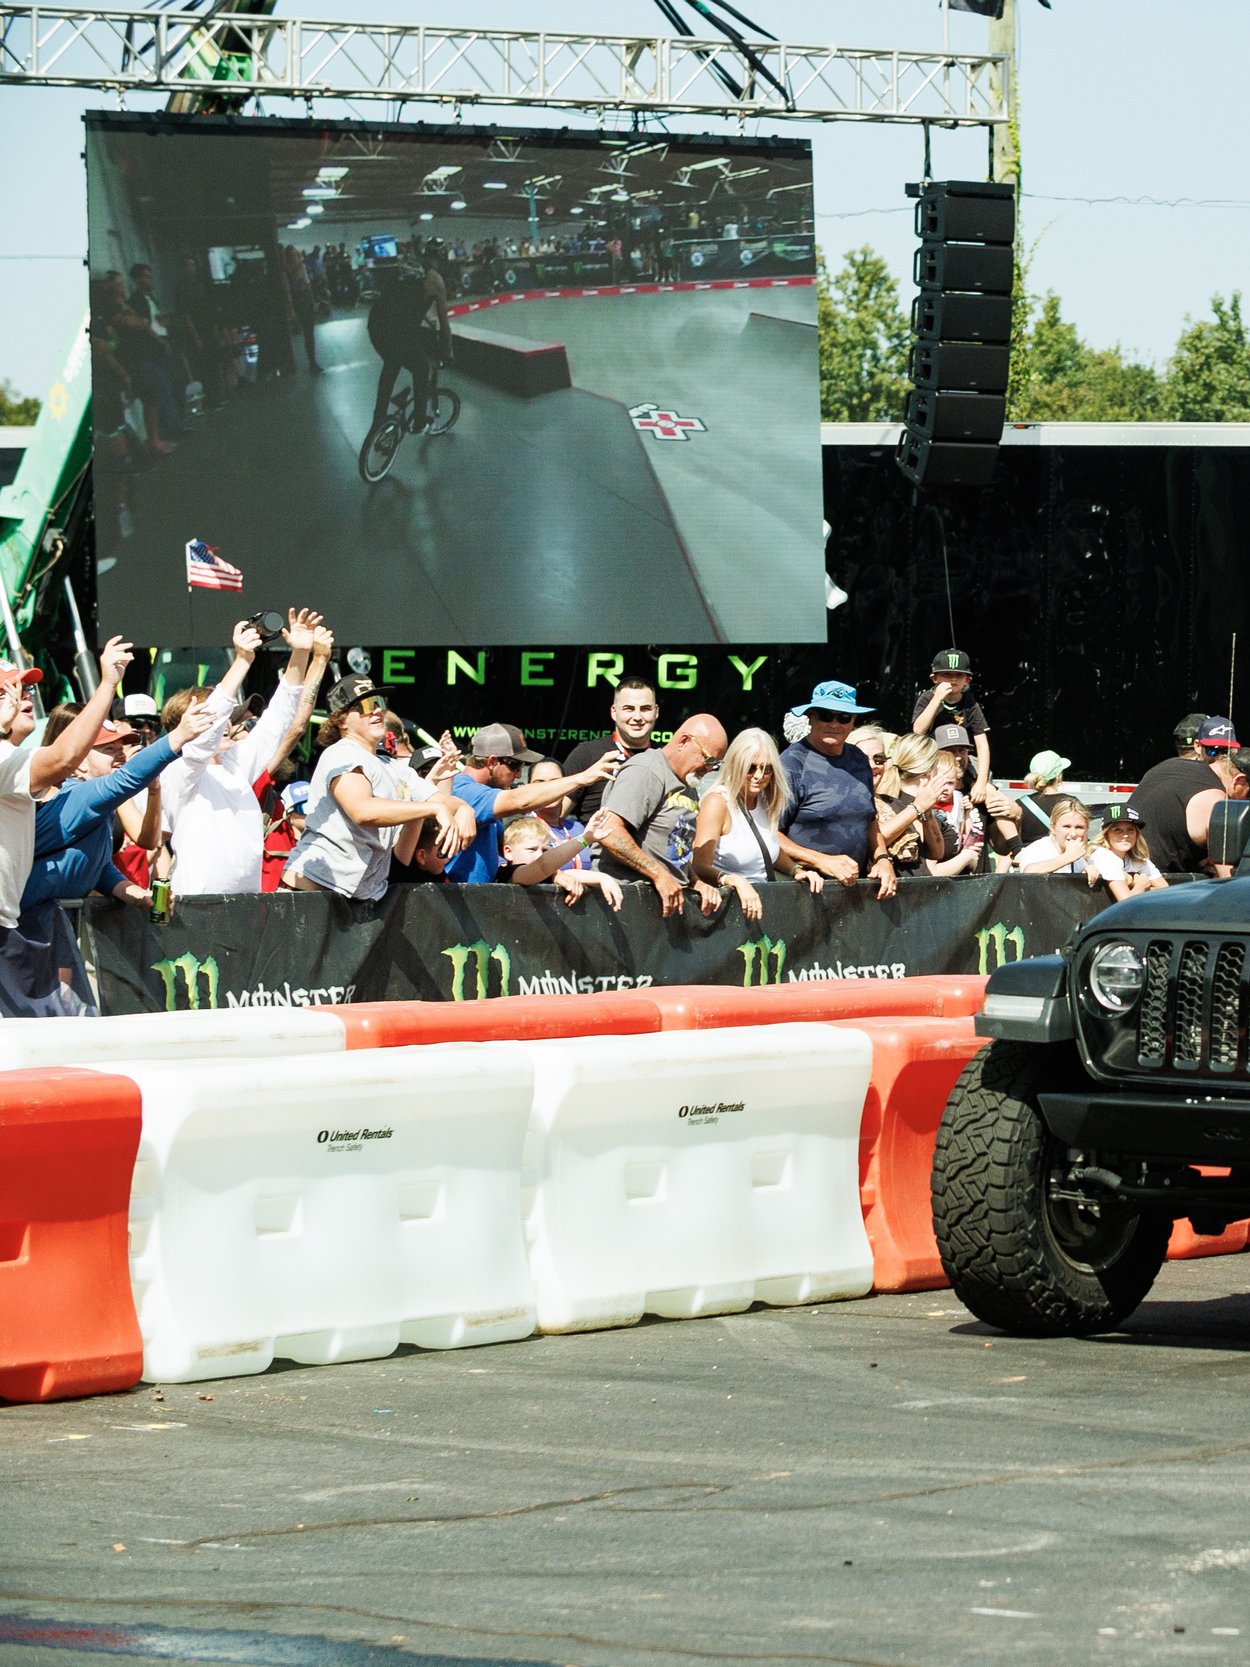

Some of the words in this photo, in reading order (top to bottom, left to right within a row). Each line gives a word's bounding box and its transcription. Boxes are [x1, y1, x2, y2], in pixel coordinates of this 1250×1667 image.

[383, 649, 768, 691] ENERGY
[690, 1103, 717, 1116] United
[716, 1101, 745, 1113] Rentals
[330, 1129, 361, 1142] United
[360, 1127, 394, 1140] Rentals
